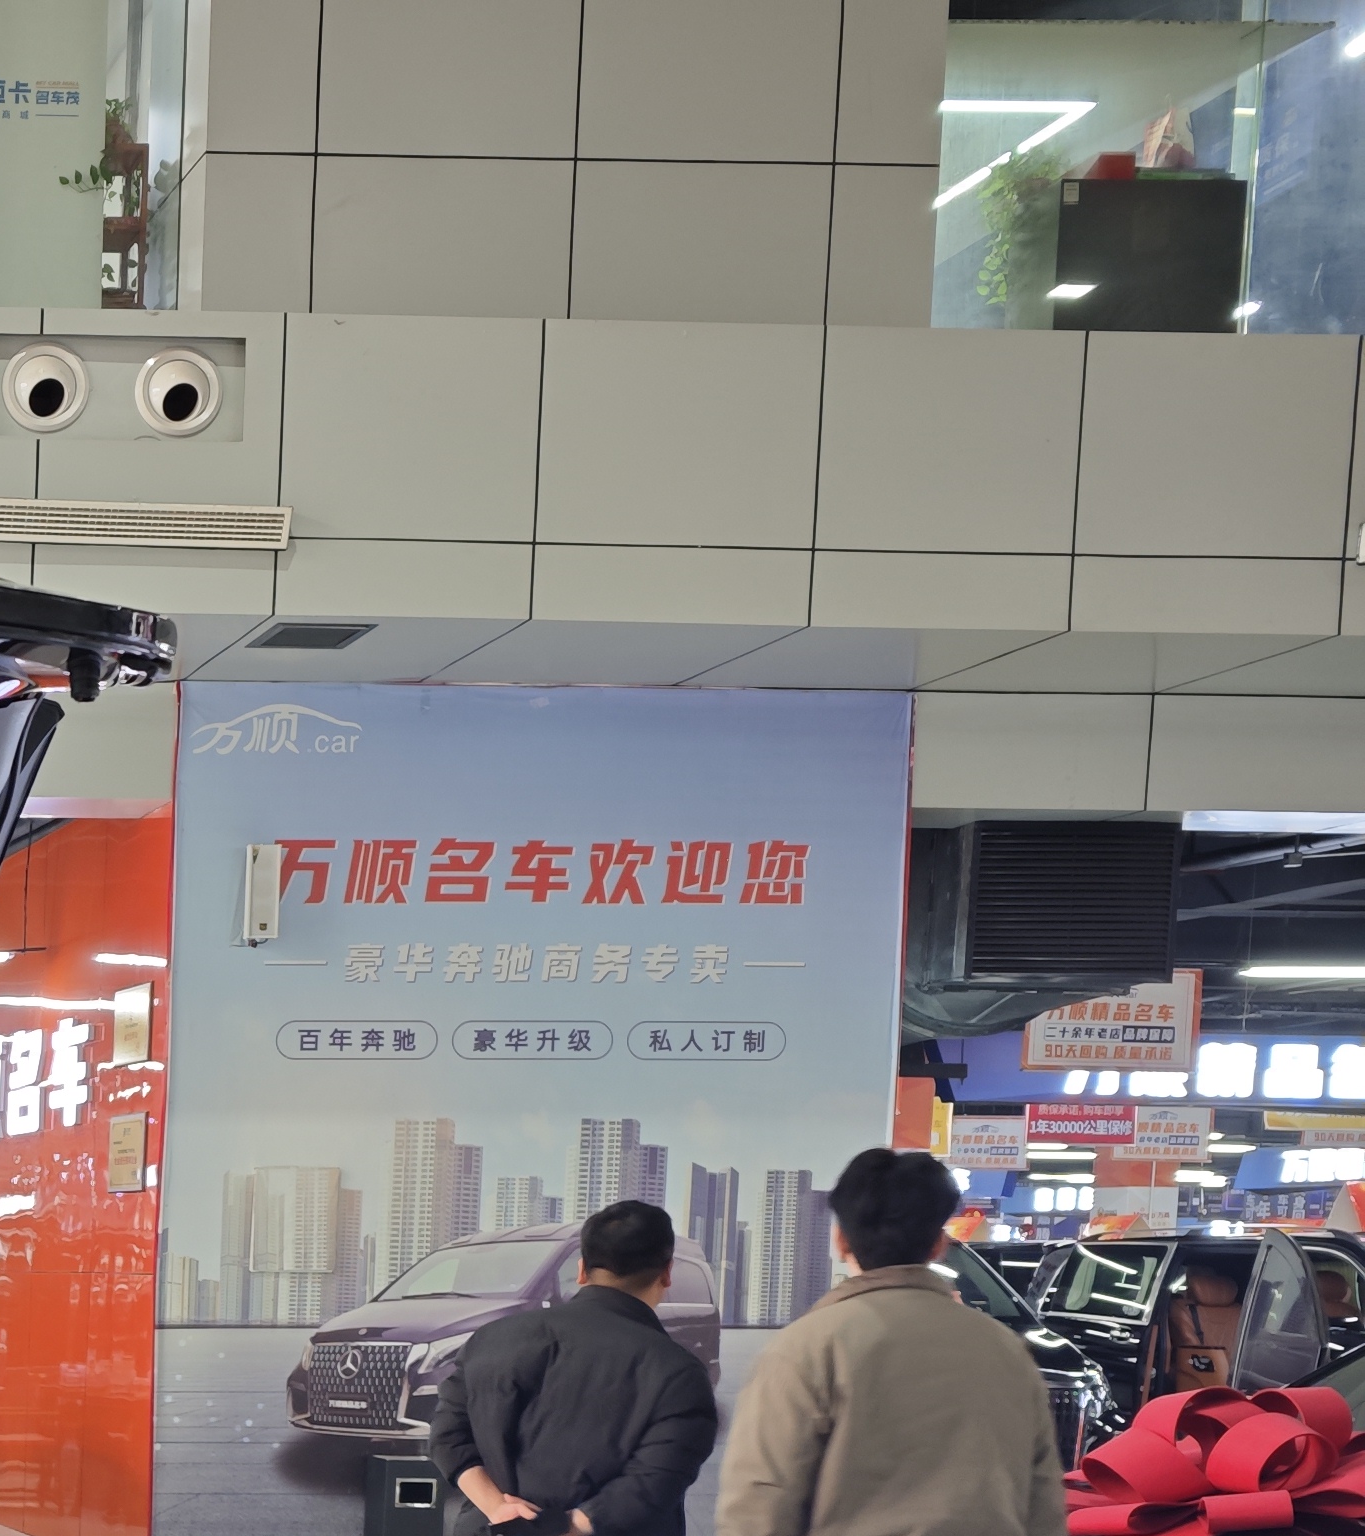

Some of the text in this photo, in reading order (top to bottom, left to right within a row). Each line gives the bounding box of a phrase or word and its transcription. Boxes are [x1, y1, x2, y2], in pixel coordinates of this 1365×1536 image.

[191, 708, 300, 756] 万顺
[273, 838, 812, 905] 万顺名车欢迎您
[343, 944, 731, 984] 豪华奔驰商务专卖
[298, 1028, 417, 1053] 百年奔驰
[472, 1028, 593, 1053] 豪华升级
[648, 1028, 767, 1054] 私人订制
[1045, 1026, 1121, 1040] 二十余年老店
[1044, 1044, 1108, 1058] 90天回购
[1029, 1120, 1133, 1135] 1年30000公里保修
